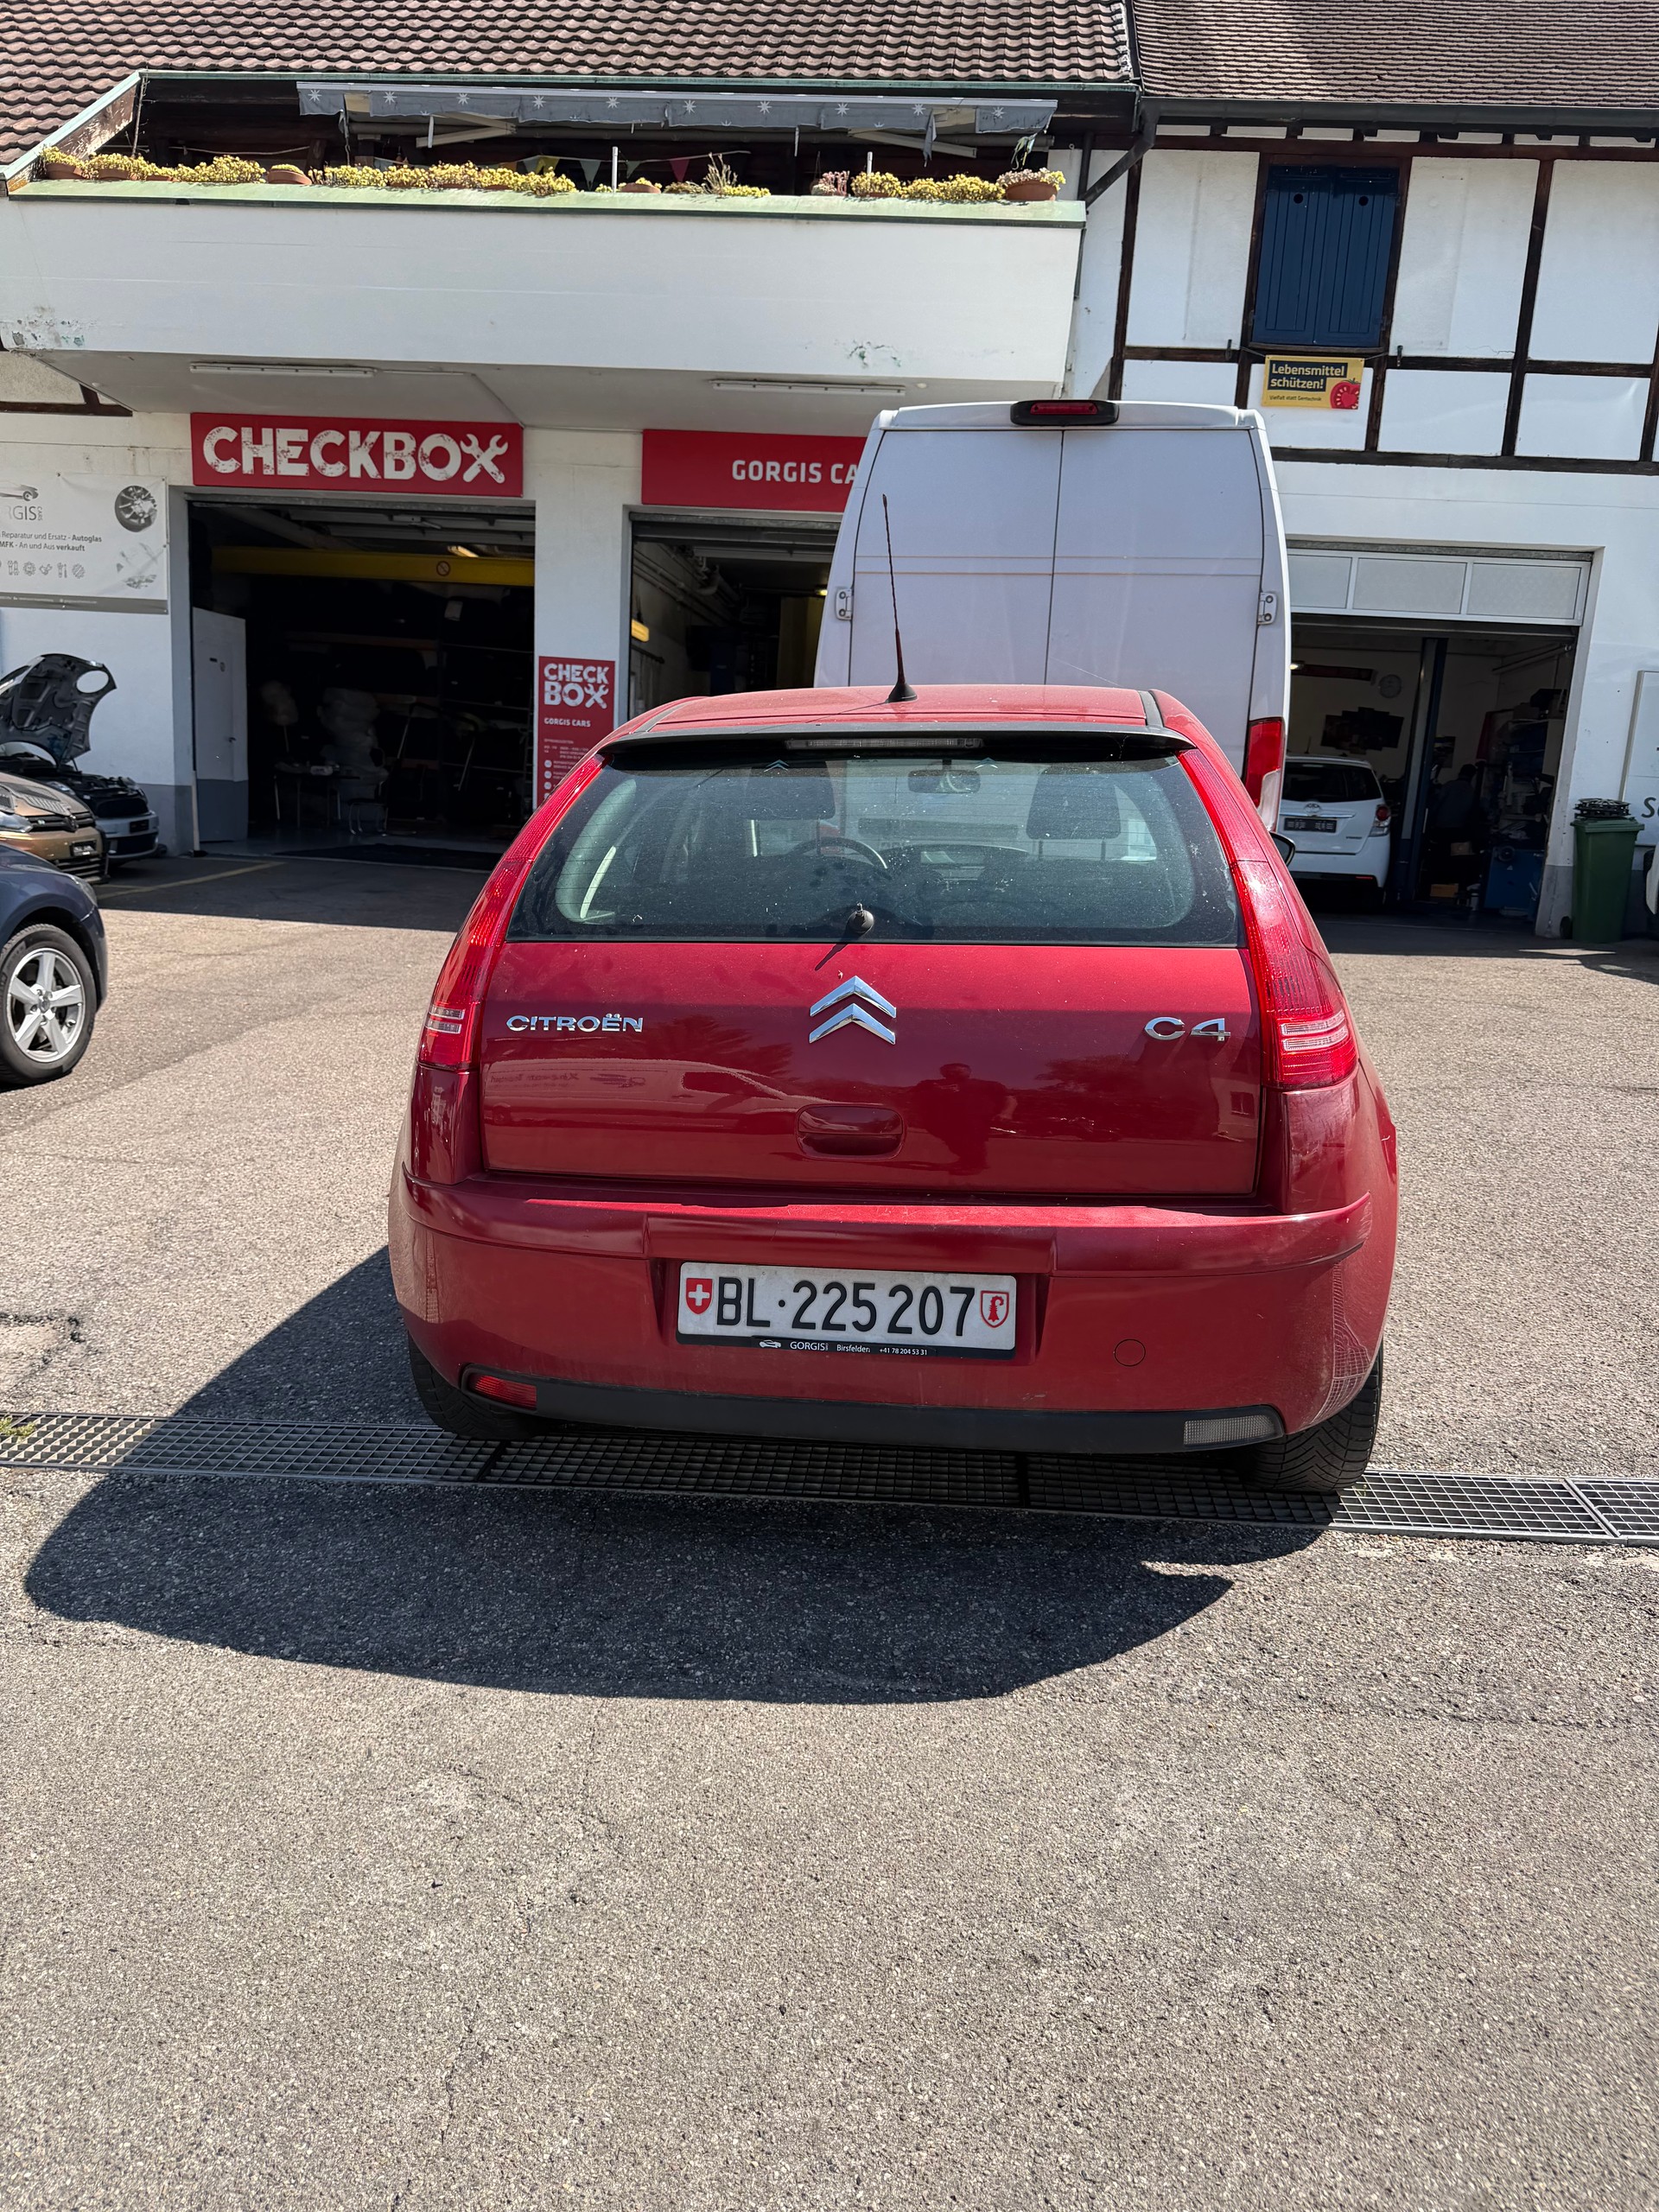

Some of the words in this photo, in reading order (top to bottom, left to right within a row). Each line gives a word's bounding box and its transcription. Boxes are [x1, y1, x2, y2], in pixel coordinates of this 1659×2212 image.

[1271, 364, 1345, 377] Lebensmittel
[1270, 377, 1324, 389] schützen!
[203, 426, 509, 484] CHECKBOX
[732, 460, 823, 484] GORGIS
[830, 463, 859, 485] CA
[2, 531, 33, 539] Reparatur
[72, 534, 102, 543] Autoglas
[543, 663, 609, 684] CHECK
[543, 681, 609, 709] BOX
[543, 717, 570, 727] GORGIS
[571, 719, 591, 728] CARS
[506, 1013, 644, 1033] CITROËN
[790, 1340, 825, 1352] GORGIS
[836, 1344, 871, 1353] Birsfelden
